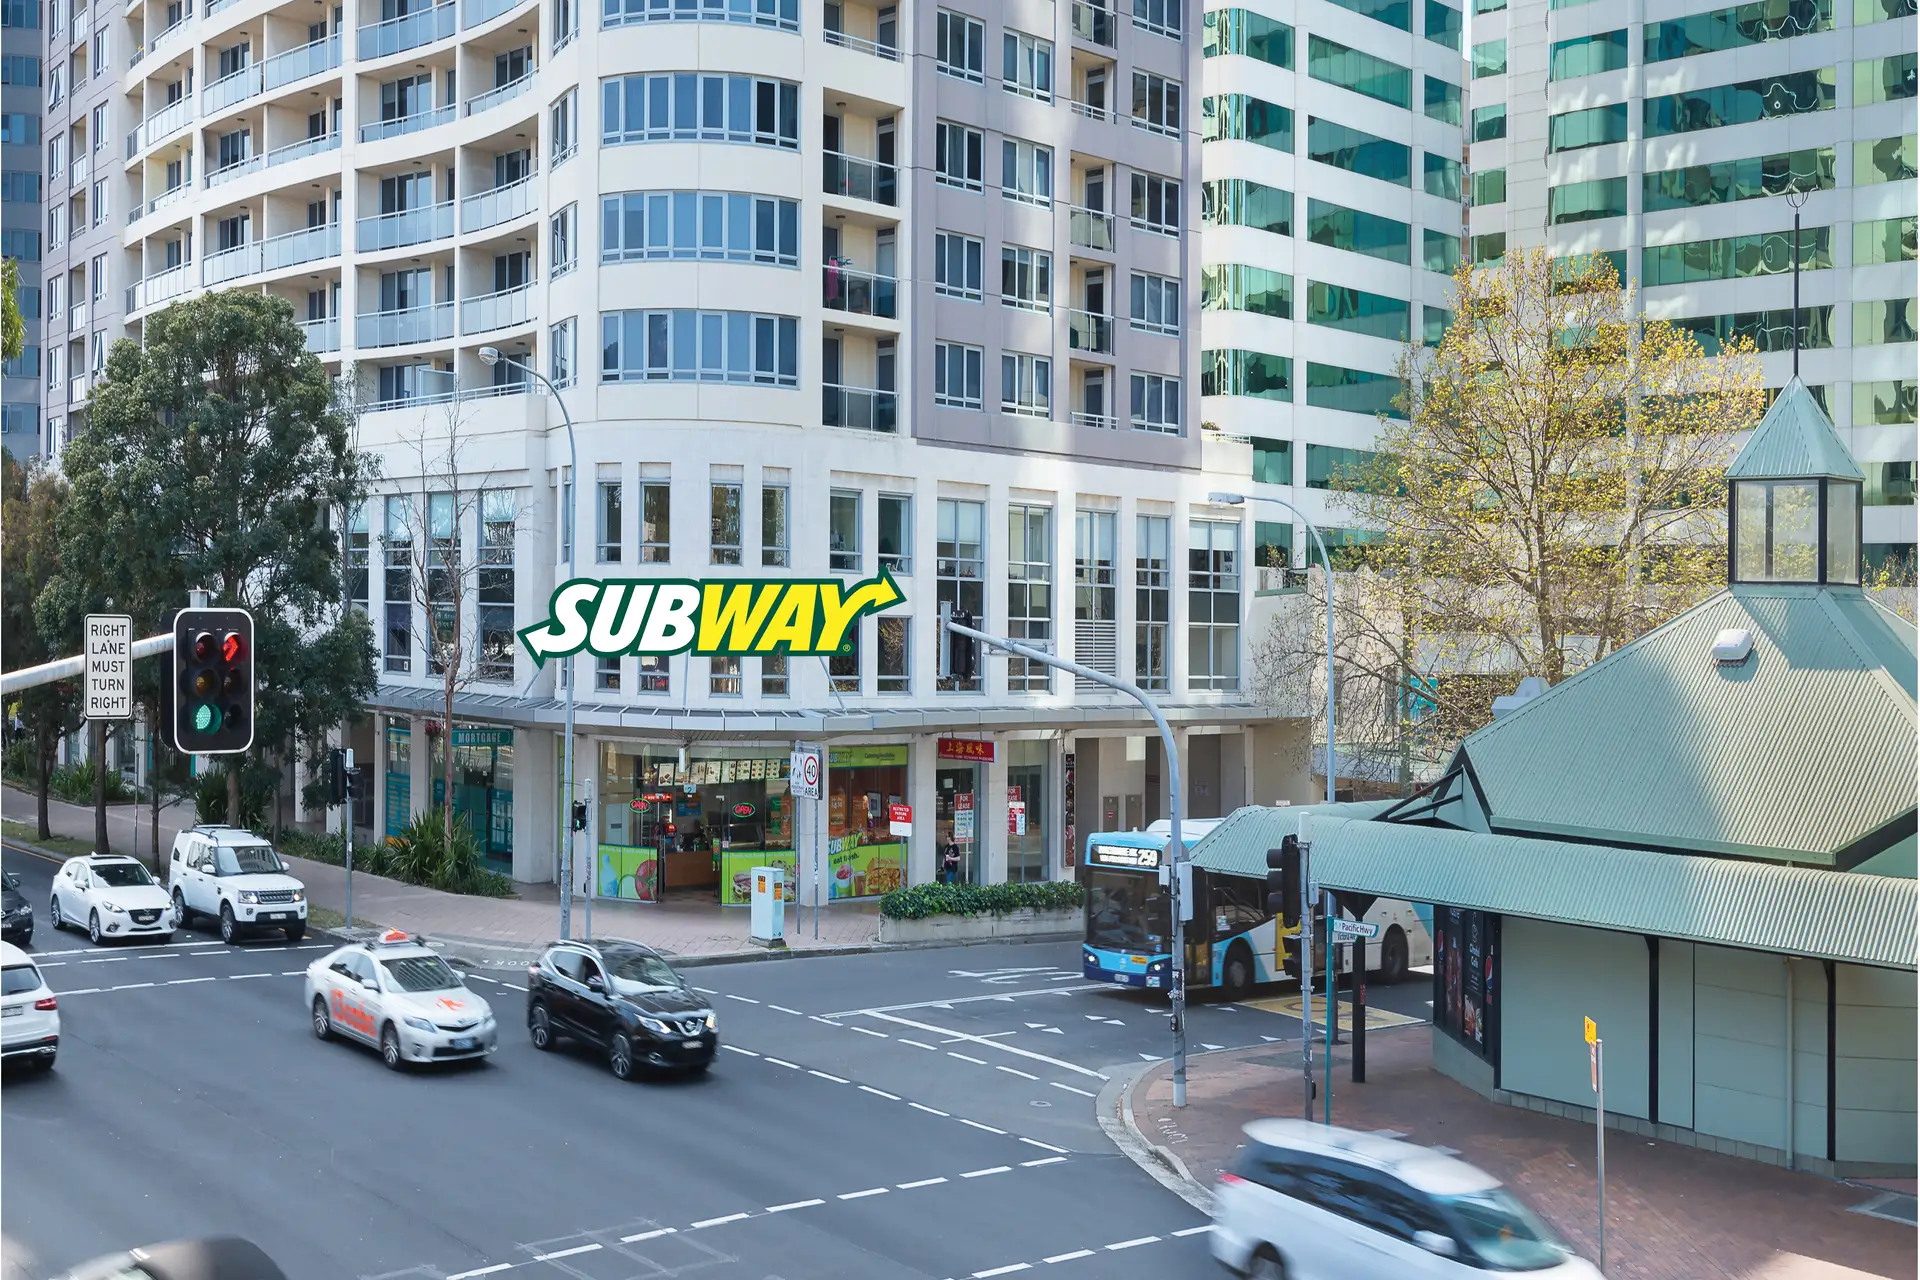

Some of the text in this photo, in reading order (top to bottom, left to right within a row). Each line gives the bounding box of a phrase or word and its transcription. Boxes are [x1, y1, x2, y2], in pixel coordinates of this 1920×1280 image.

[91, 624, 126, 636] RIGHT
[92, 643, 125, 655] LANE
[92, 661, 125, 673] MUST
[92, 679, 124, 691] TURN
[91, 697, 126, 709] RIGHT
[458, 732, 501, 743] MORTGAGE
[807, 764, 816, 778] 40
[804, 787, 818, 797] AREA
[734, 804, 752, 814] OPEN
[1342, 922, 1373, 935] Pacific Hwy
